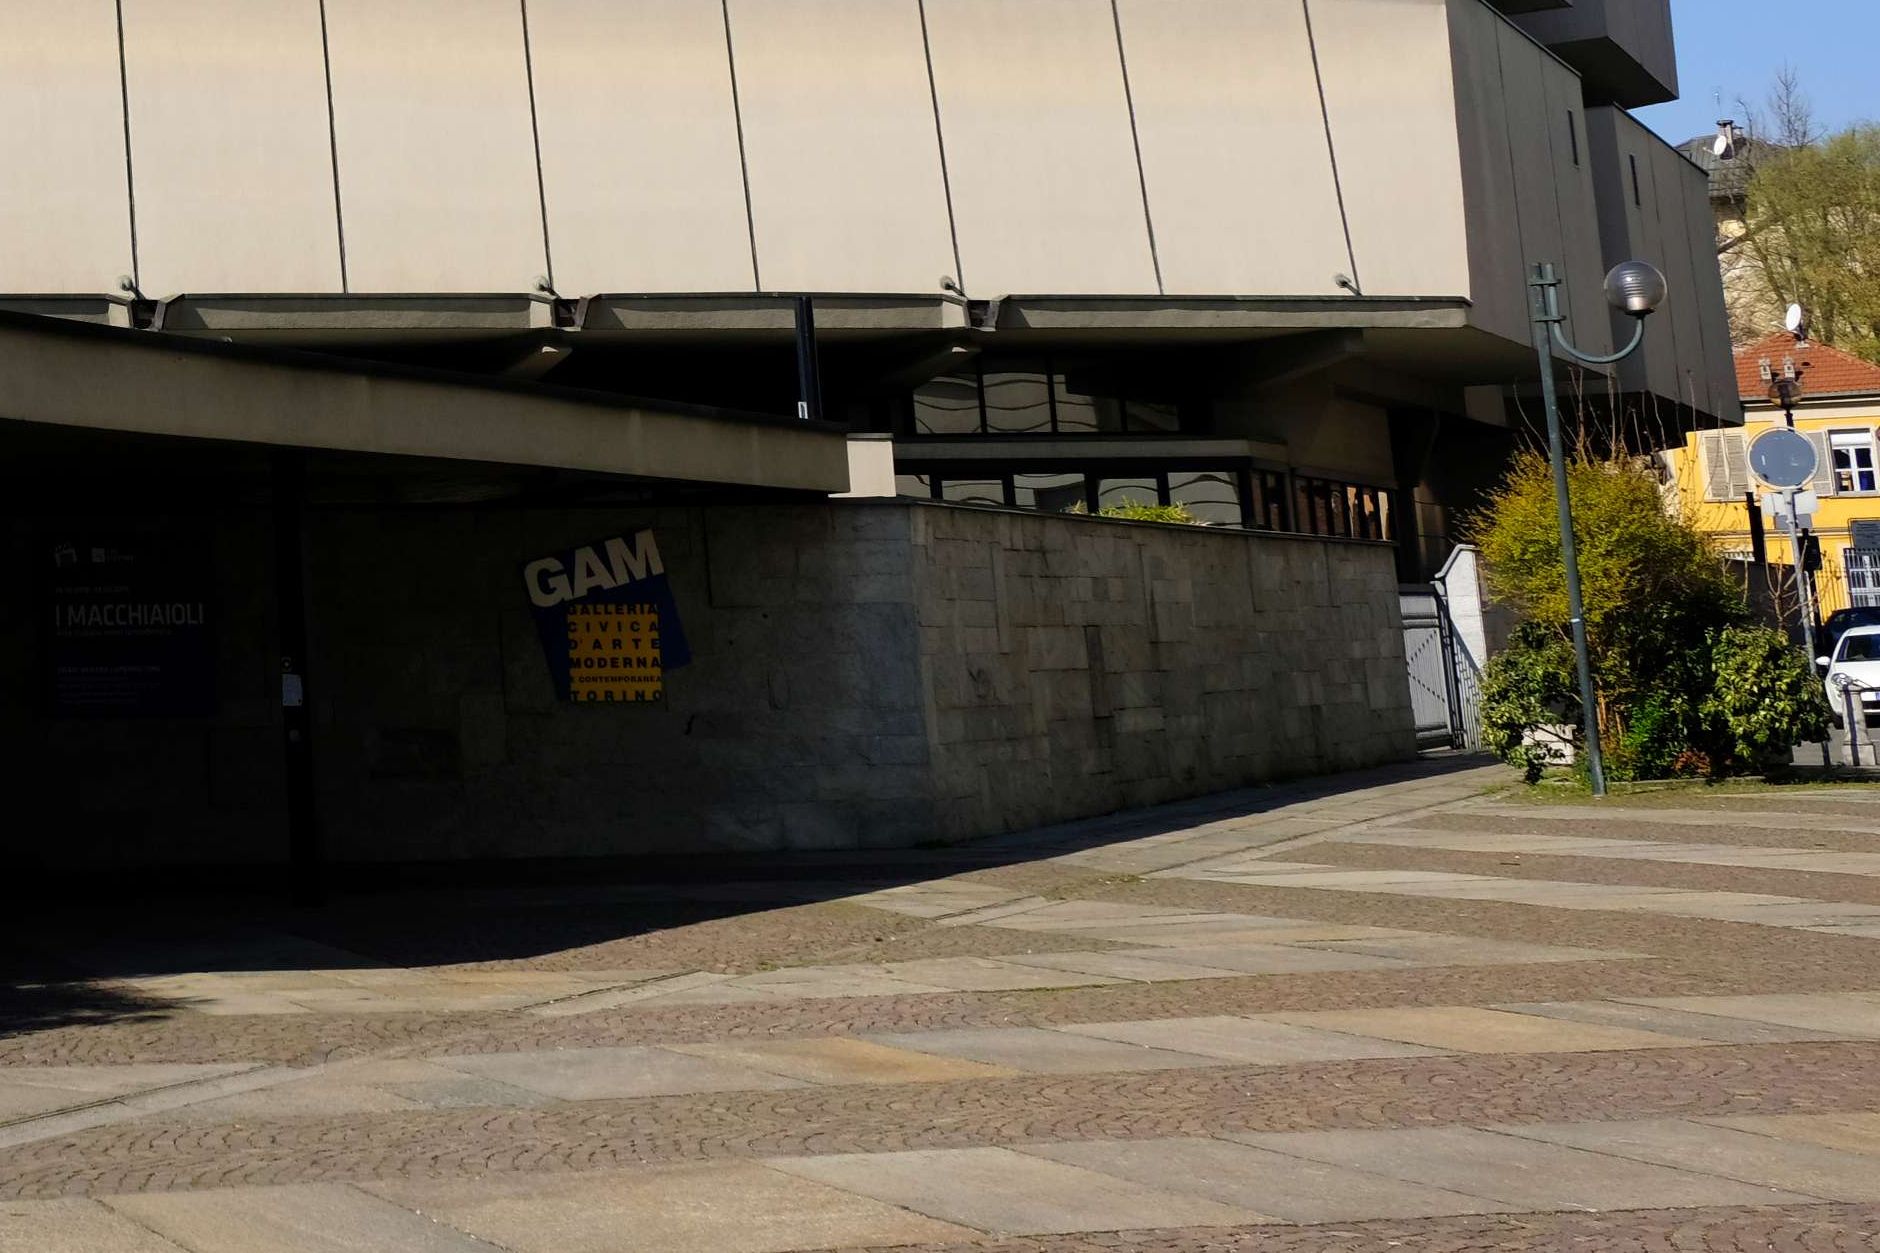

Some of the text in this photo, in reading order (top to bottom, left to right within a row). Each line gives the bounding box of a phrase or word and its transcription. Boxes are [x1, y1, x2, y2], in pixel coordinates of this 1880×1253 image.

[524, 528, 665, 608] GAM
[55, 602, 205, 627] I MACCHIAIOLI
[568, 604, 660, 616] GALLERIA
[568, 621, 661, 633] CIVICA
[568, 657, 663, 668] MODERNA
[568, 690, 663, 702] TORINO
